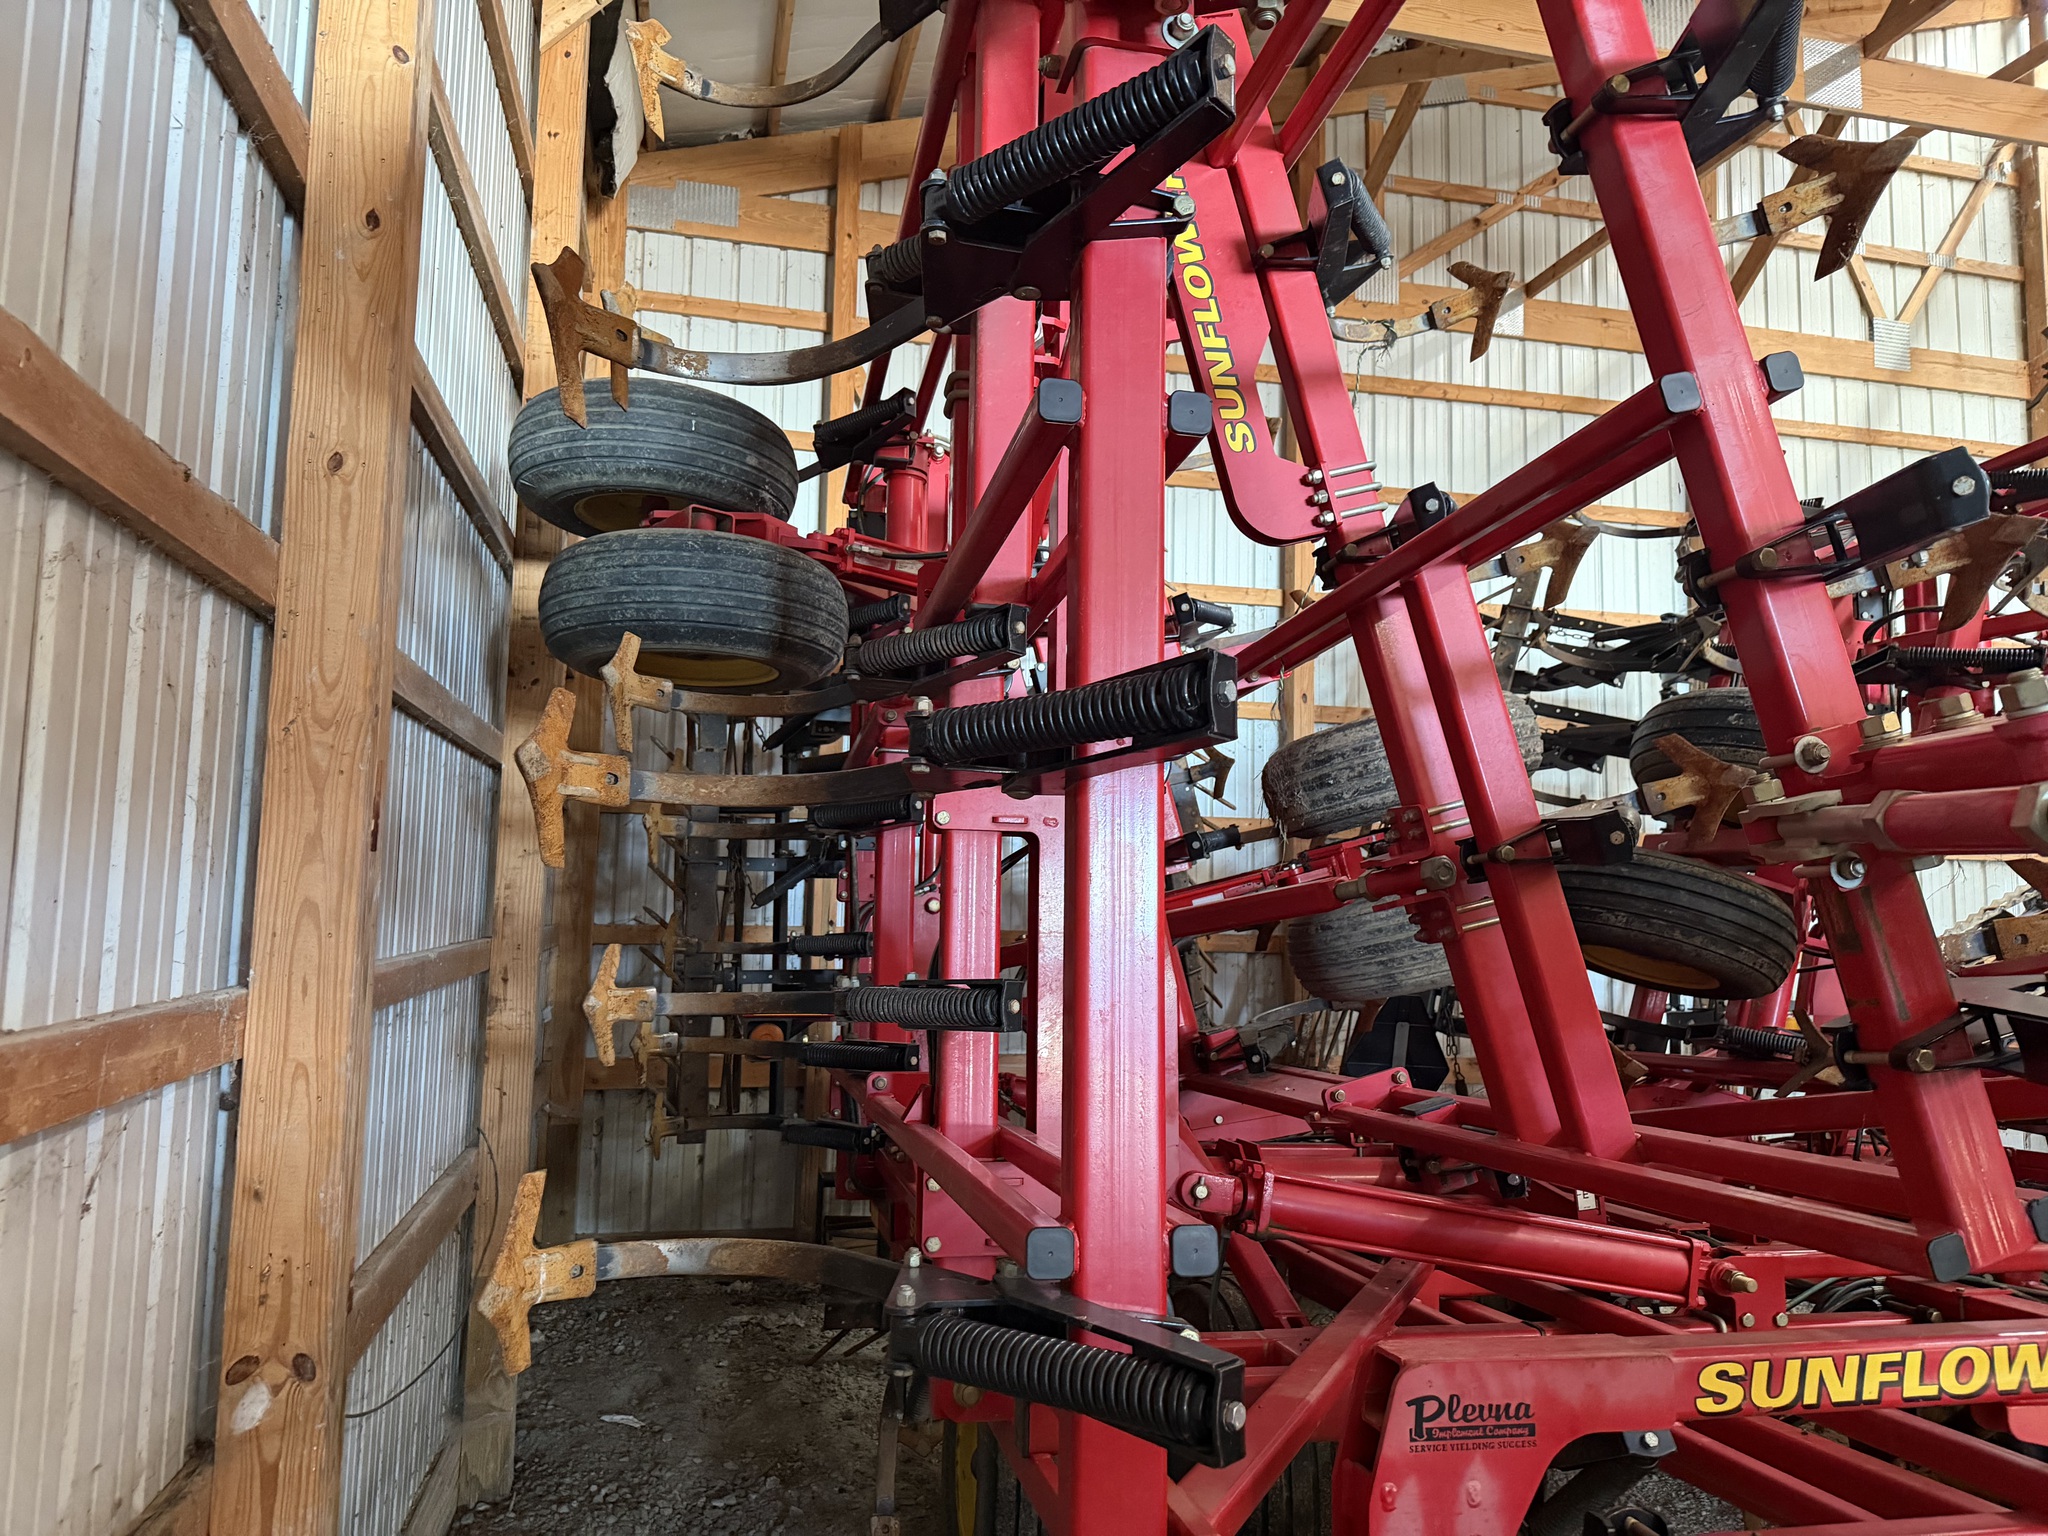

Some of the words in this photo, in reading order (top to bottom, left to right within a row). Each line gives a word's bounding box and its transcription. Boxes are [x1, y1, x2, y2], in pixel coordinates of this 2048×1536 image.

[1405, 1393, 1535, 1440] Plevna
[1431, 1426, 1484, 1440] Implement
[1485, 1425, 1530, 1437] Company
[1409, 1443, 1448, 1453] SERVICE
[1449, 1441, 1496, 1451] YIELDING
[1497, 1439, 1538, 1449] SUCCESS
